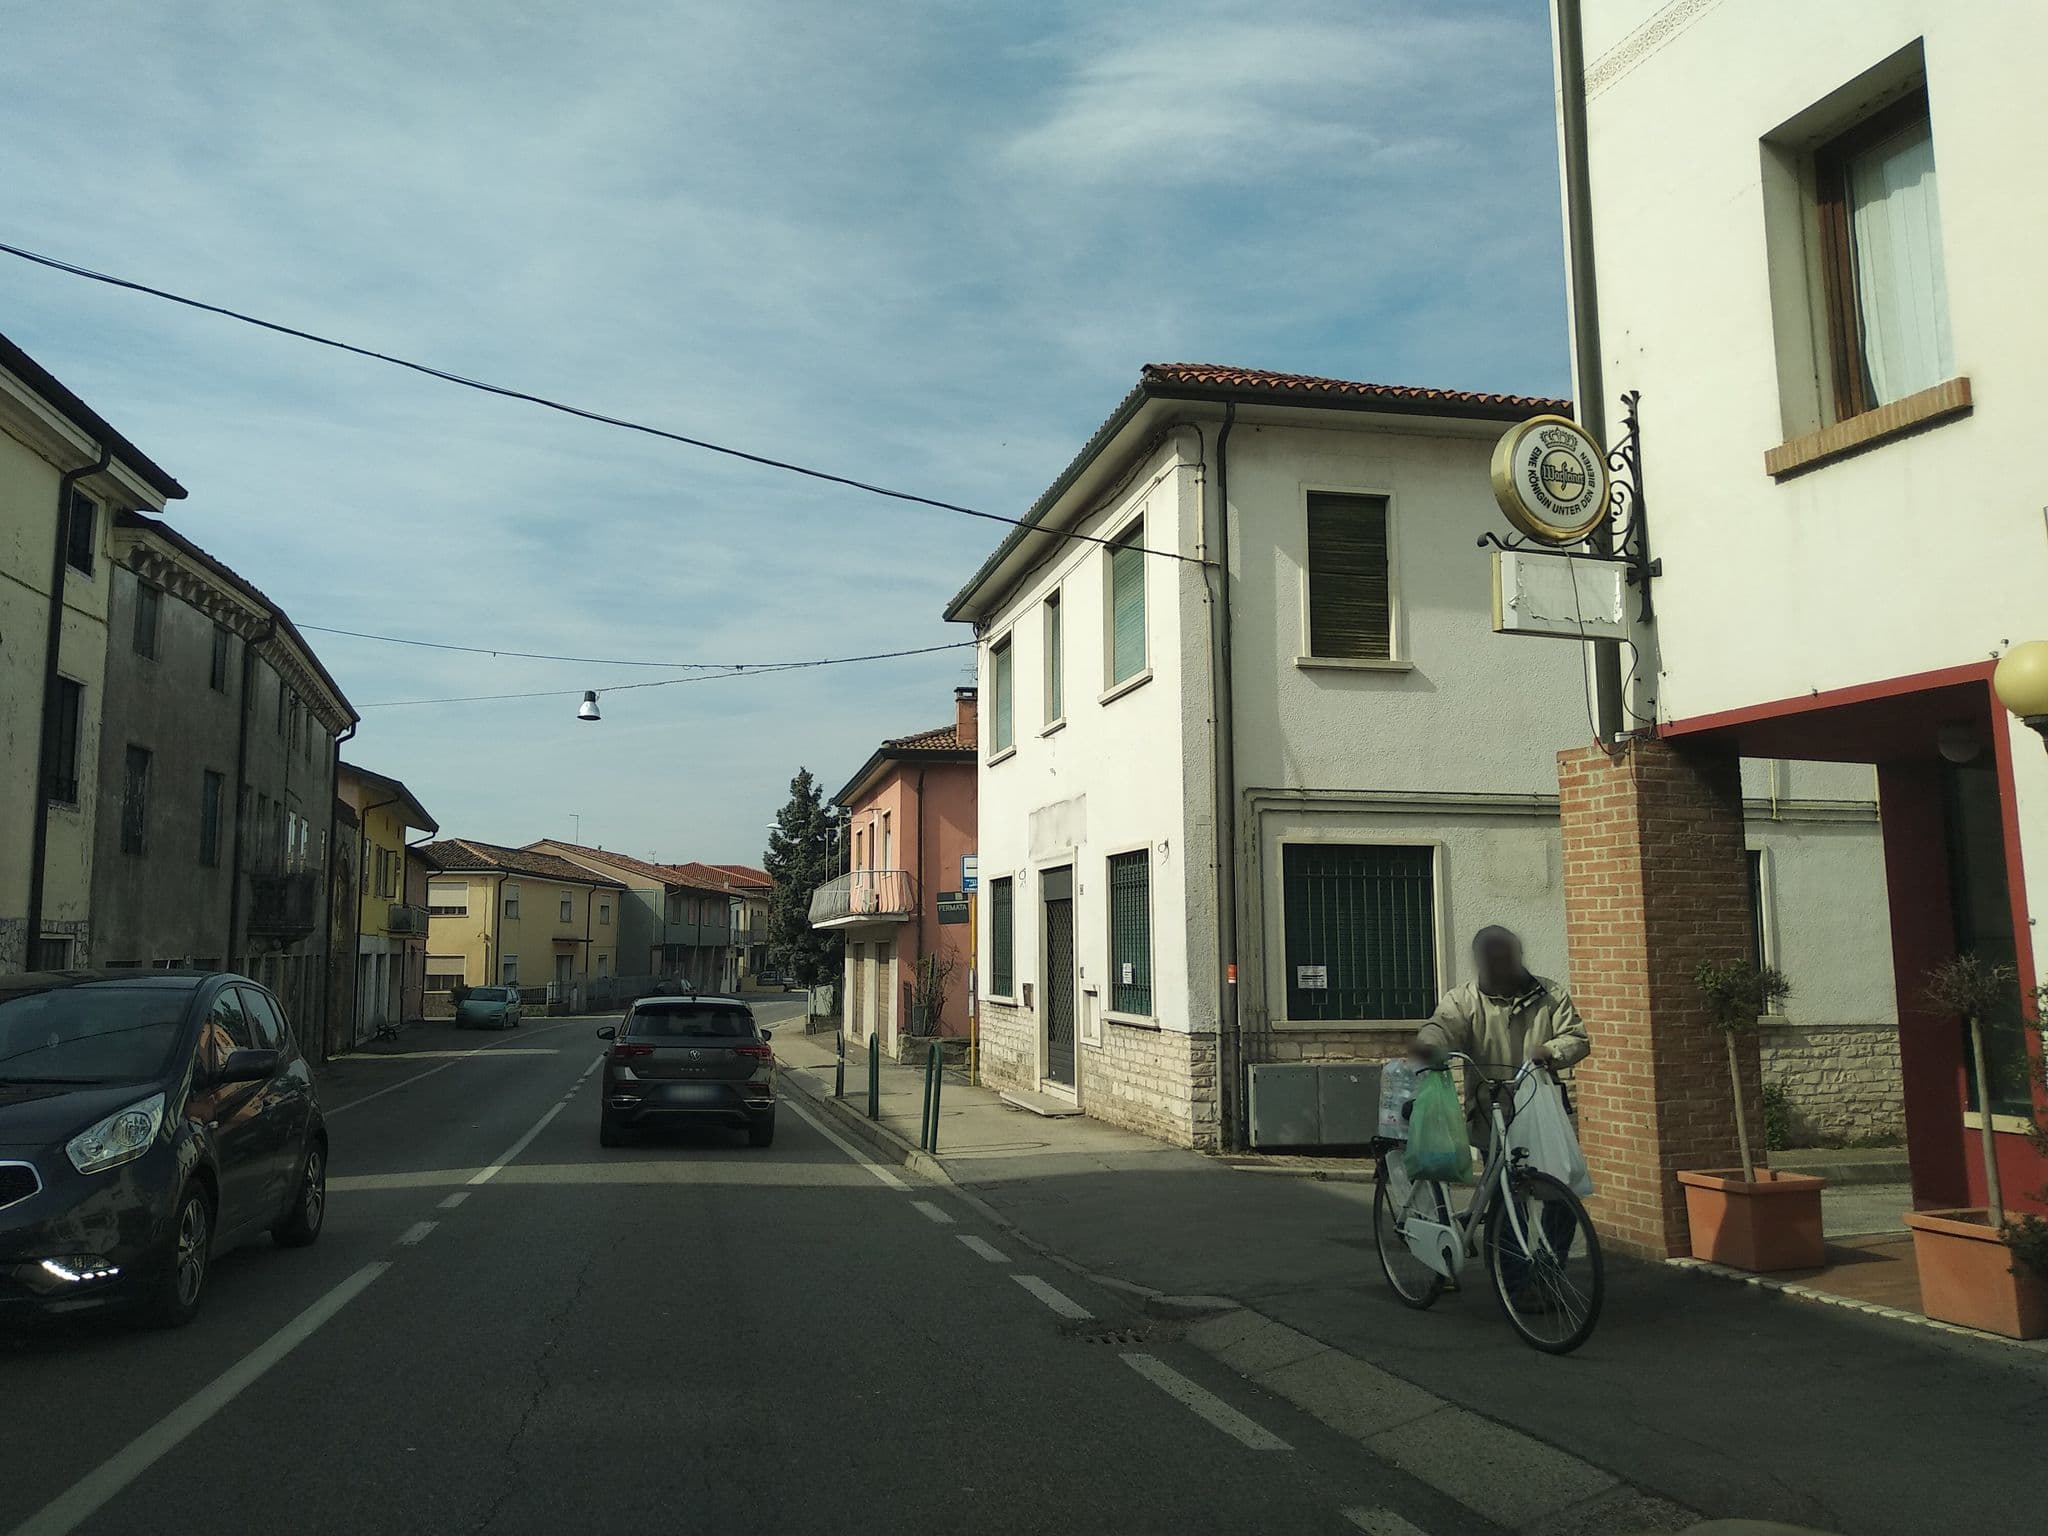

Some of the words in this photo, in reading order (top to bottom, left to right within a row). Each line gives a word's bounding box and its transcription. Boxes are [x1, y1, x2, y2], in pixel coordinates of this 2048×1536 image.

[1528, 446, 1542, 468] EINE
[1579, 452, 1596, 488] BIEREN
[1528, 469, 1552, 509] KÖNIGIN
[1580, 489, 1594, 509] DEN
[1552, 504, 1581, 515] UNTER
[938, 904, 967, 912] FERMATA
